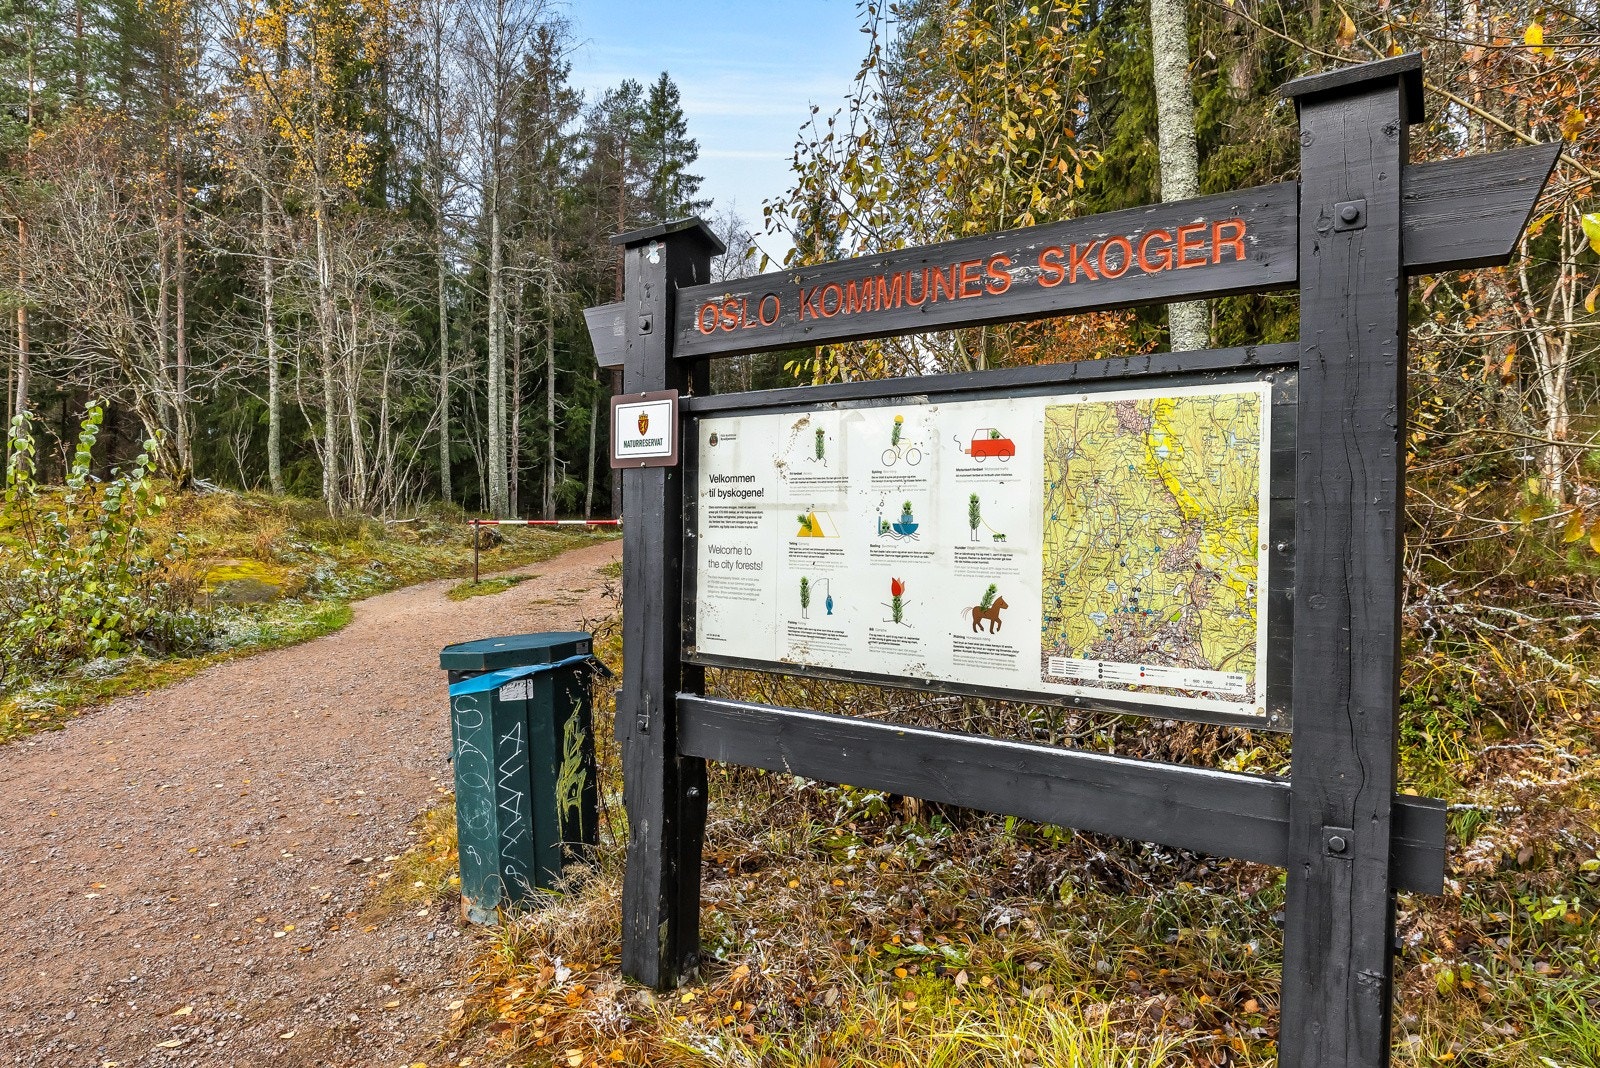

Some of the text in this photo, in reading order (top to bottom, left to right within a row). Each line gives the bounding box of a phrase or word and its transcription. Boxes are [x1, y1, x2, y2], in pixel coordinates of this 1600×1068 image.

[699, 217, 1247, 335] OSLO KOMMUNES SKOGER
[623, 437, 663, 449] NATURRESERVAT
[708, 473, 756, 484] Velkommen
[708, 487, 765, 499] til byskogene!
[707, 544, 753, 556] Welcome to
[707, 559, 764, 571] the city forests!
